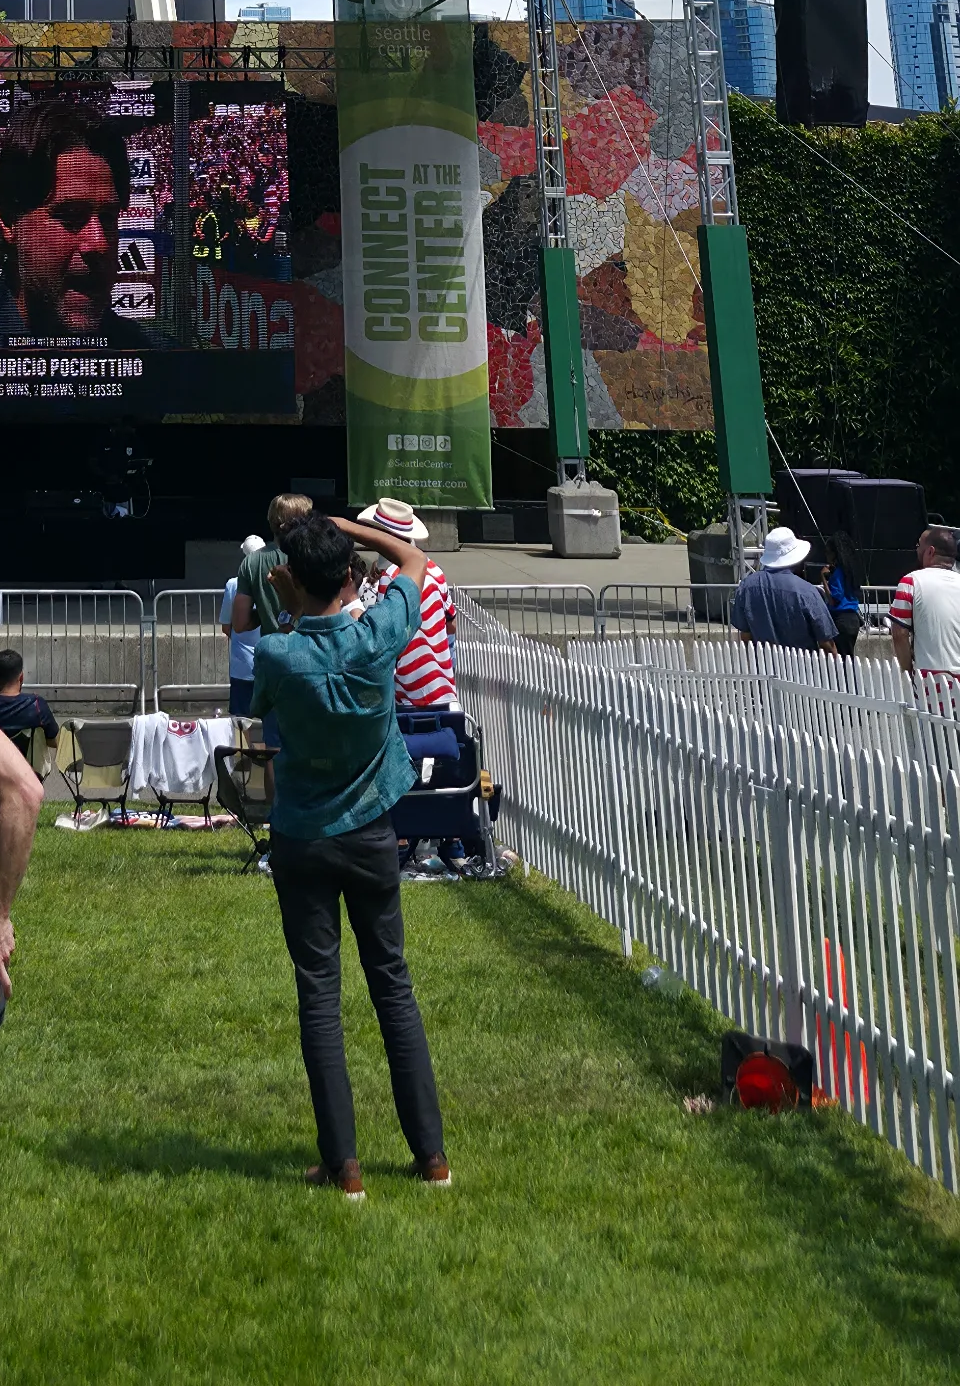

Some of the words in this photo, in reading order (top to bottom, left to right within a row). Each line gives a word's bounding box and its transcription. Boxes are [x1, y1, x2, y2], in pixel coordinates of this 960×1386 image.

[375, 24, 431, 41] seattle
[378, 43, 431, 58] center
[140, 93, 156, 102] CUP
[108, 103, 156, 117] 2026
[412, 164, 431, 185] AT
[433, 164, 462, 186] THE
[359, 162, 412, 342] CONNECT
[413, 190, 469, 343] CENTER
[8, 337, 36, 347] RECORD
[37, 337, 55, 347] WITH
[56, 337, 81, 347] UNITED
[82, 337, 108, 347] STATES
[50, 358, 143, 377] POCHETTINO
[5, 383, 33, 398] WINS,
[34, 384, 40, 396] 2
[40, 383, 76, 398] DRAWS,
[89, 383, 123, 397] LOSSES
[387, 458, 453, 469] @SeattleCenter
[373, 476, 468, 489] seattlecenter.com
